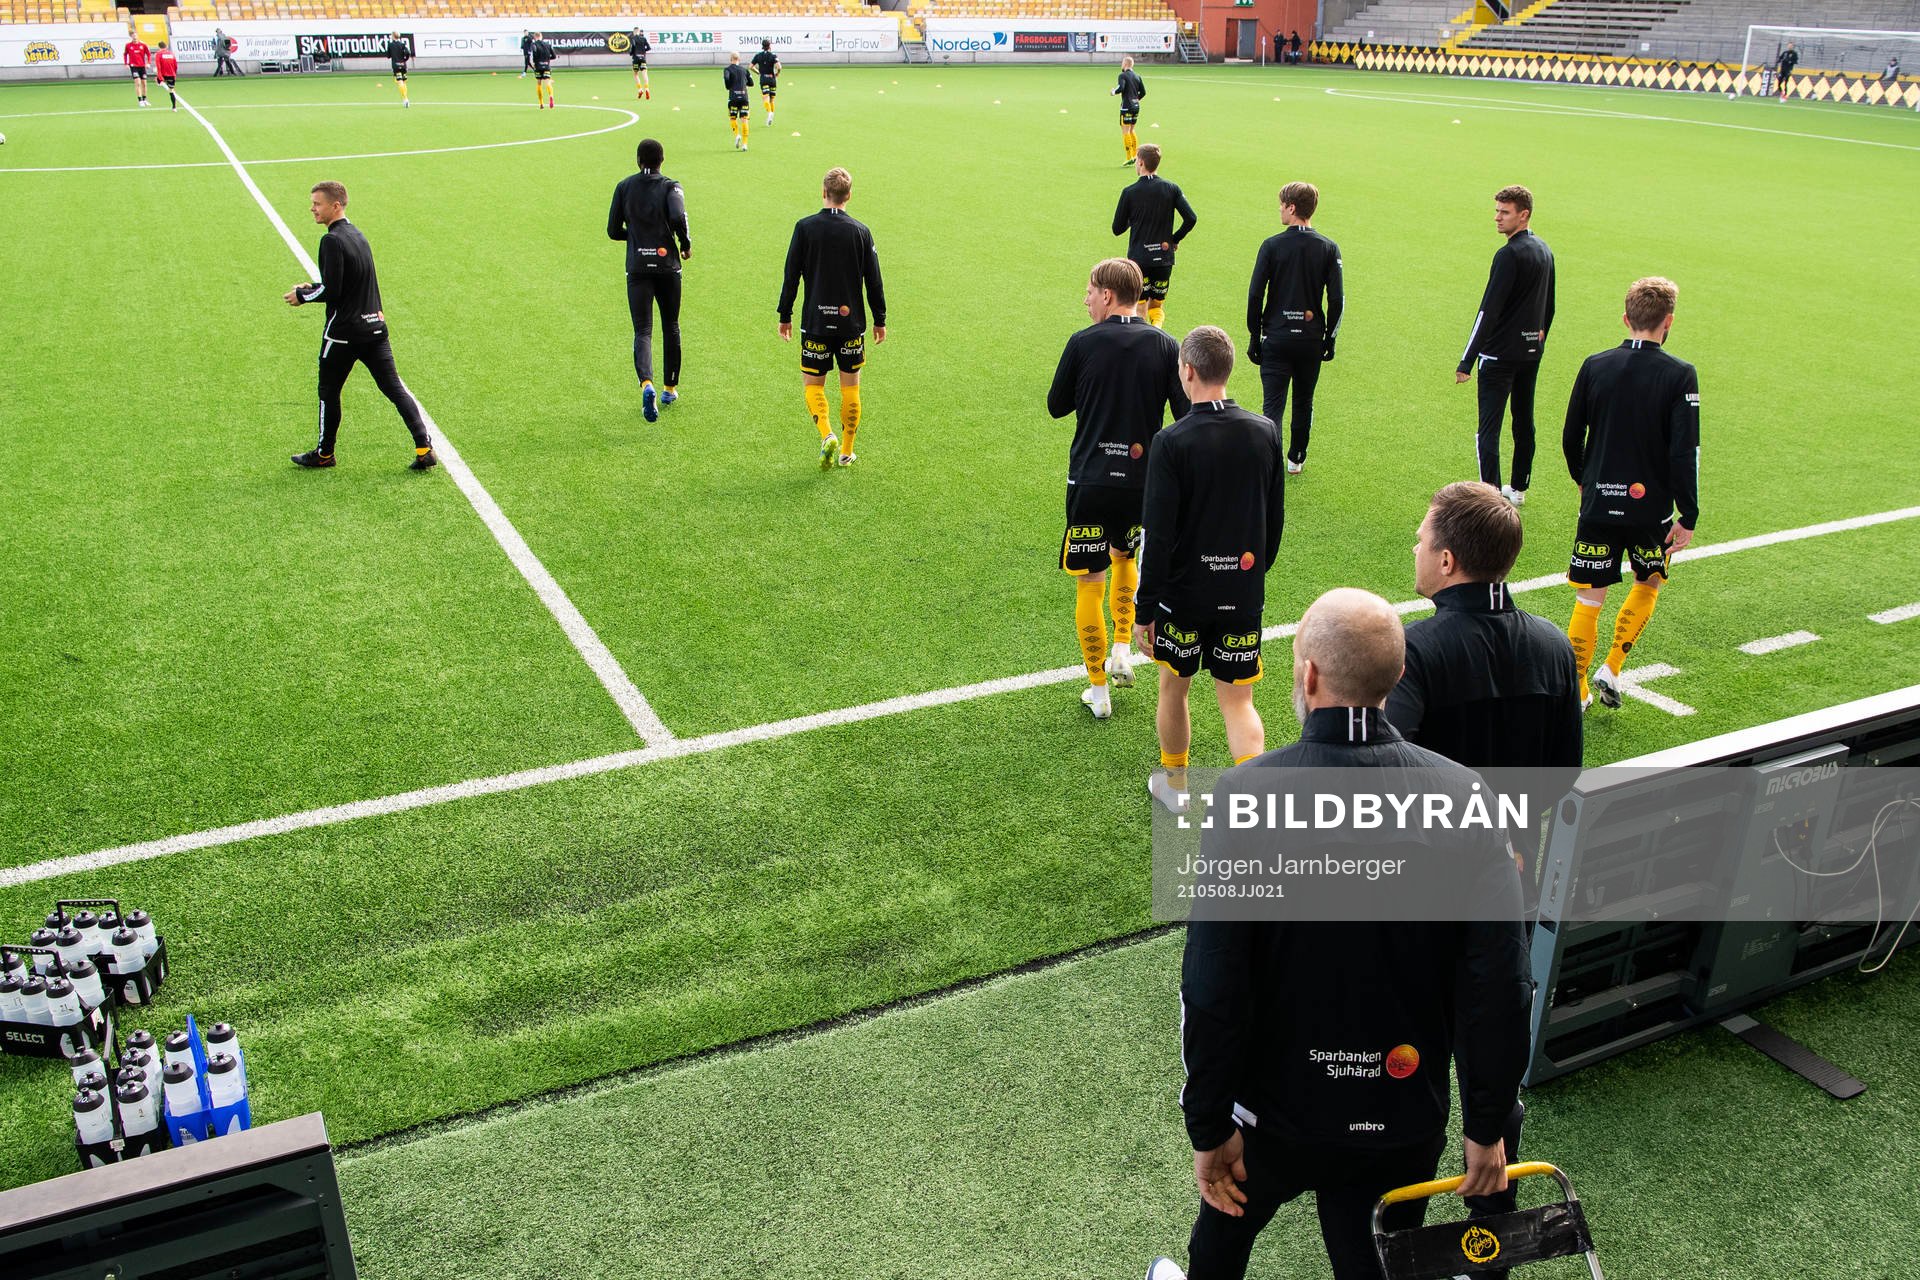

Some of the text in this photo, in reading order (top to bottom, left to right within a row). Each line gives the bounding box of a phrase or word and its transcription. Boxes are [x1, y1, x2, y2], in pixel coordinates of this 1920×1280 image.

[424, 38, 498, 49] FRONT
[658, 32, 714, 44] PEAB
[836, 38, 879, 49] ProFlow
[932, 37, 991, 50] Nordea
[177, 40, 215, 51] COMFOR
[807, 341, 825, 351] EAB
[1071, 527, 1101, 538] EAB
[1577, 543, 1607, 556] EAB
[1201, 555, 1239, 563] Sparbanken
[1571, 555, 1612, 570] Cernera
[1209, 563, 1238, 571] Sjuhärad
[1168, 625, 1196, 643] EAB
[1156, 635, 1201, 658] Cernera
[1226, 634, 1257, 648] EAB
[1213, 646, 1259, 662] Cerner
[6, 1031, 45, 1044] SELECT
[1309, 1049, 1381, 1063] Sparbanken
[1326, 1063, 1381, 1079] Sjuhärad
[1349, 1121, 1385, 1131] umbro
